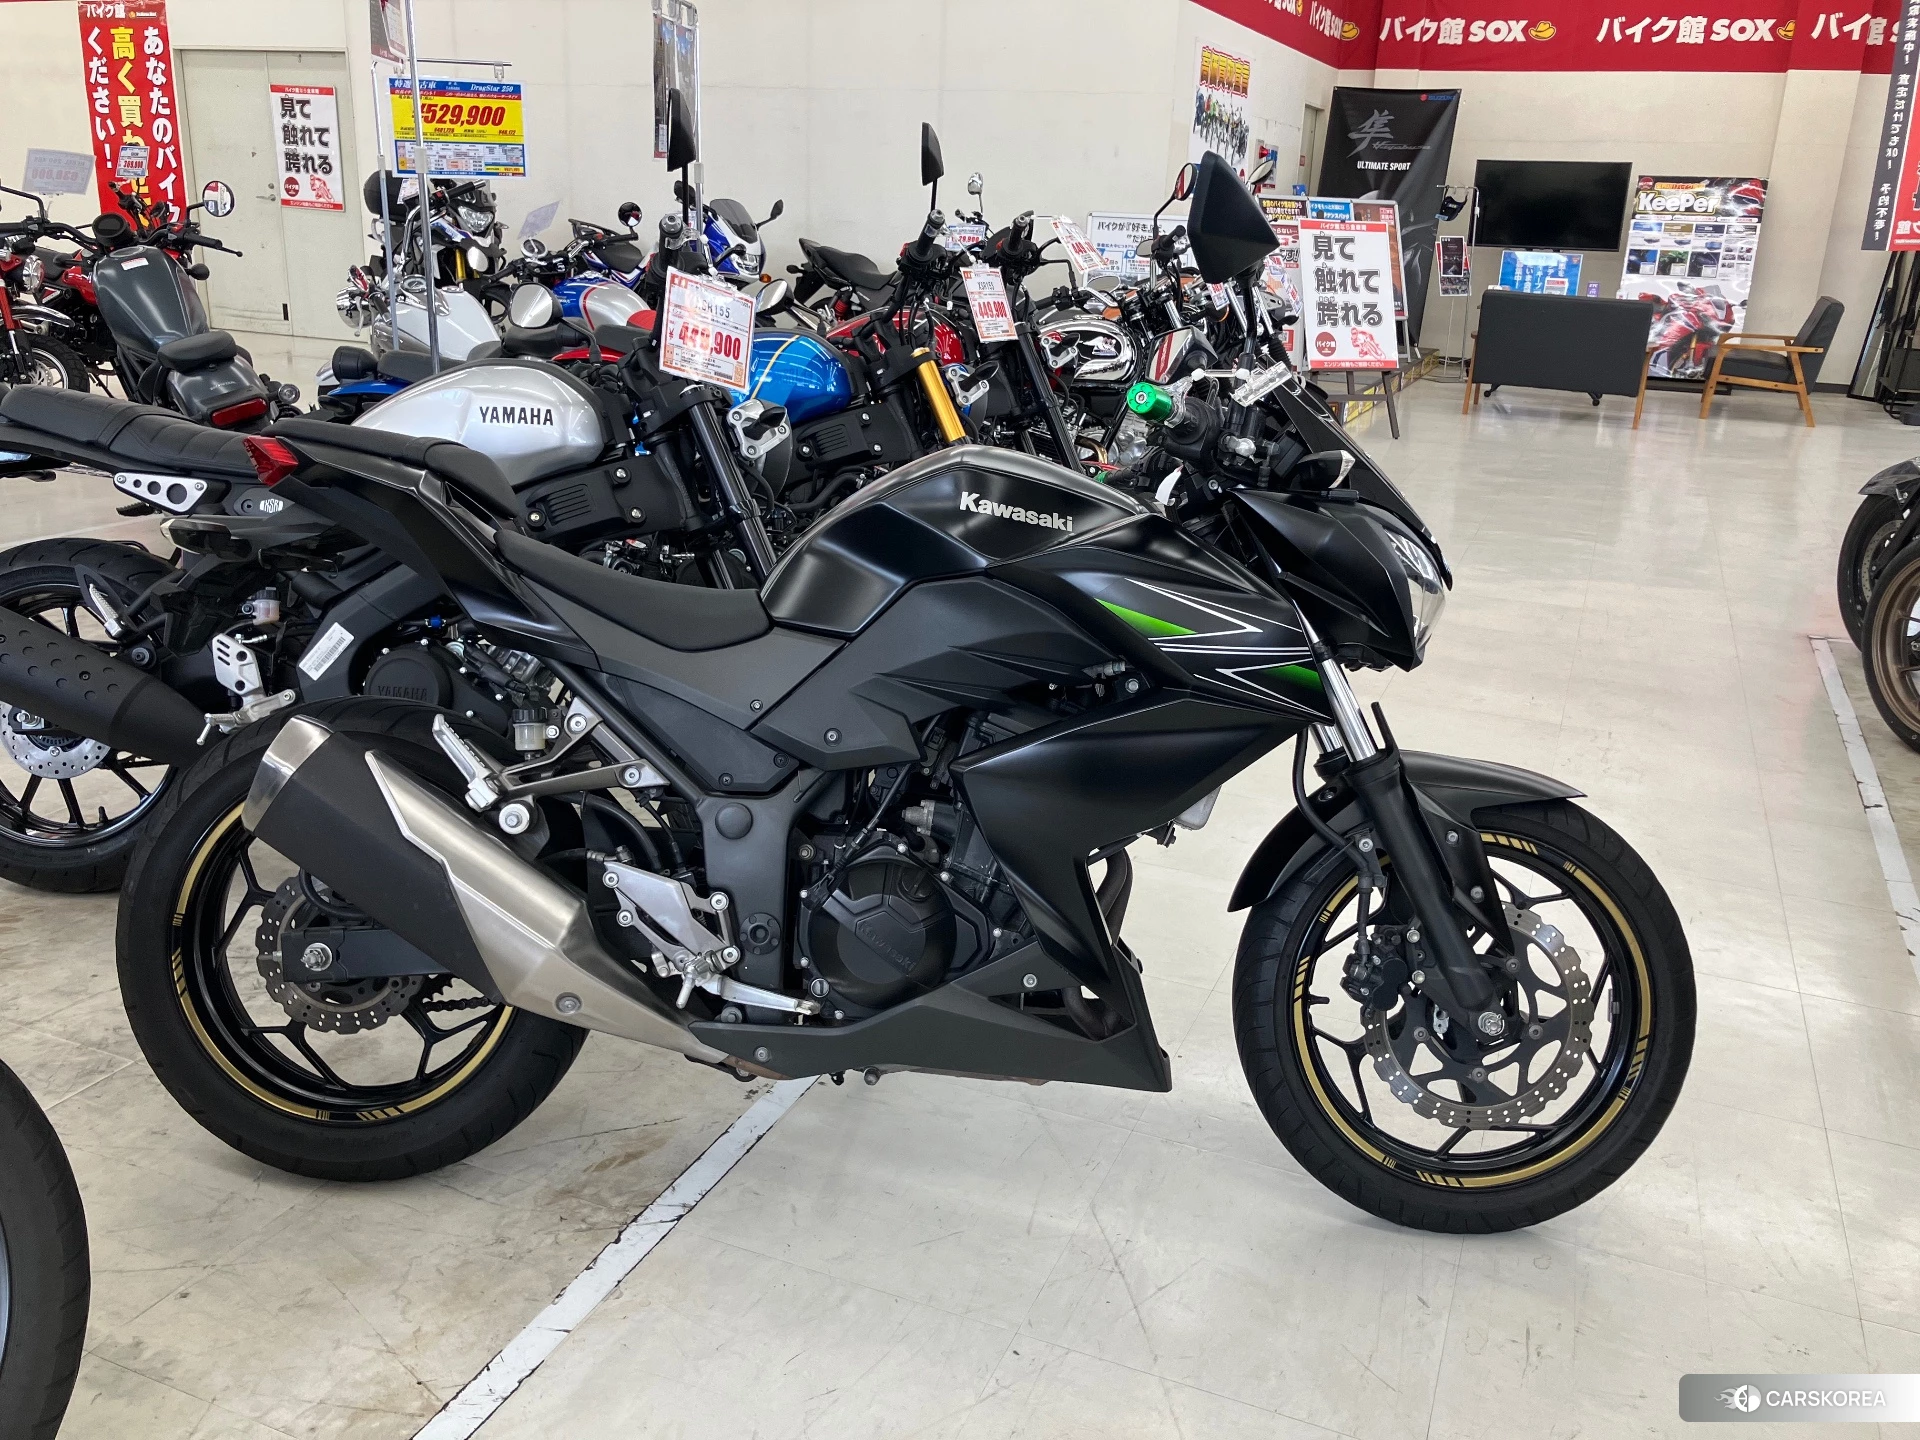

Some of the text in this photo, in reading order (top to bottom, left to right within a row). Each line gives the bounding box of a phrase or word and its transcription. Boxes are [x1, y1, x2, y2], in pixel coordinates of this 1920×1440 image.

[87, 3, 126, 18] バイク館
[1309, 1, 1332, 37] バイク館
[1379, 17, 1528, 44] バイク館 SOX
[1596, 16, 1777, 44] バイク館 SOX
[394, 79, 437, 89] 特選古車
[470, 84, 500, 92] DragStar
[87, 26, 116, 169] ください!
[281, 97, 311, 118] 見て
[282, 125, 330, 147] 触れて
[1346, 109, 1395, 158] 隼
[284, 152, 333, 174] 跨れる
[1357, 160, 1412, 171] ULTIMATE SPORT
[1638, 192, 1720, 213] KeePer
[1313, 235, 1355, 261] 見て
[1314, 267, 1380, 294] 触れて
[978, 301, 1007, 319] 449,900
[1317, 301, 1383, 327] 跨れる
[1316, 340, 1336, 348] バイク館
[479, 406, 553, 426] YAMAHA
[259, 505, 285, 518] XSR
[960, 491, 1073, 532] Kawasaki
[378, 686, 428, 701] YAMAHA
[857, 921, 916, 971] Kawasaki
